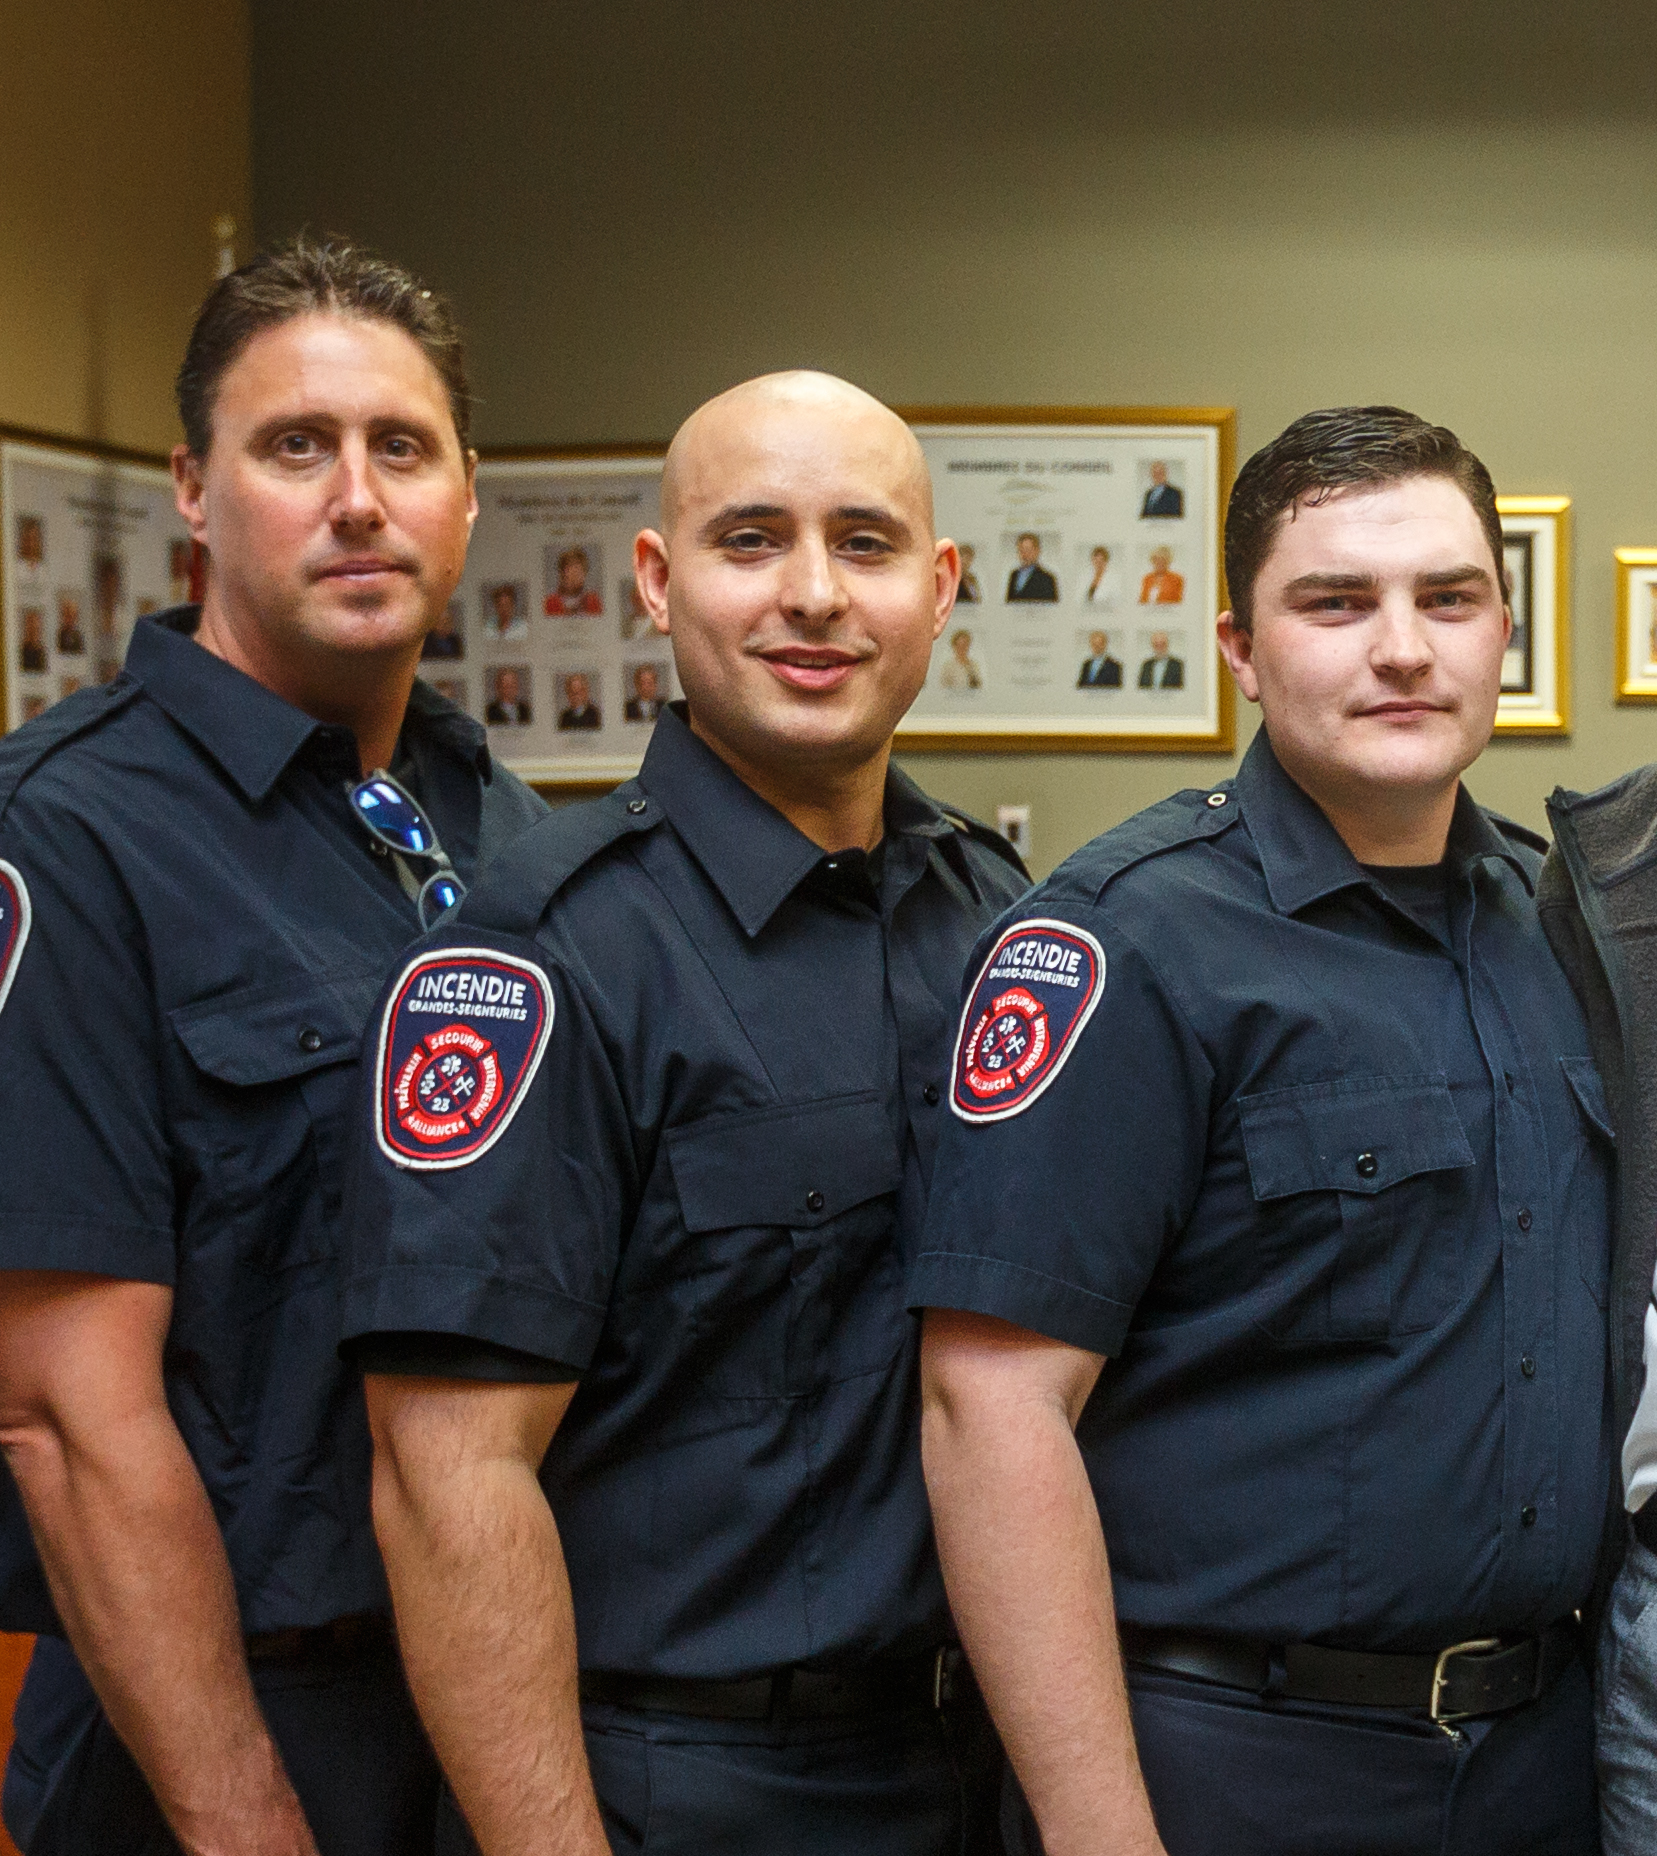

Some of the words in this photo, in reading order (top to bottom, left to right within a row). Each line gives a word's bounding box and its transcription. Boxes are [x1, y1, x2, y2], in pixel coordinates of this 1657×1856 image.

[998, 941, 1082, 973] INCENDIE
[418, 973, 527, 1006] INCENDIE
[431, 1032, 485, 1052] SECOURIR
[988, 1055, 1003, 1069] 23
[431, 1097, 450, 1112] 23
